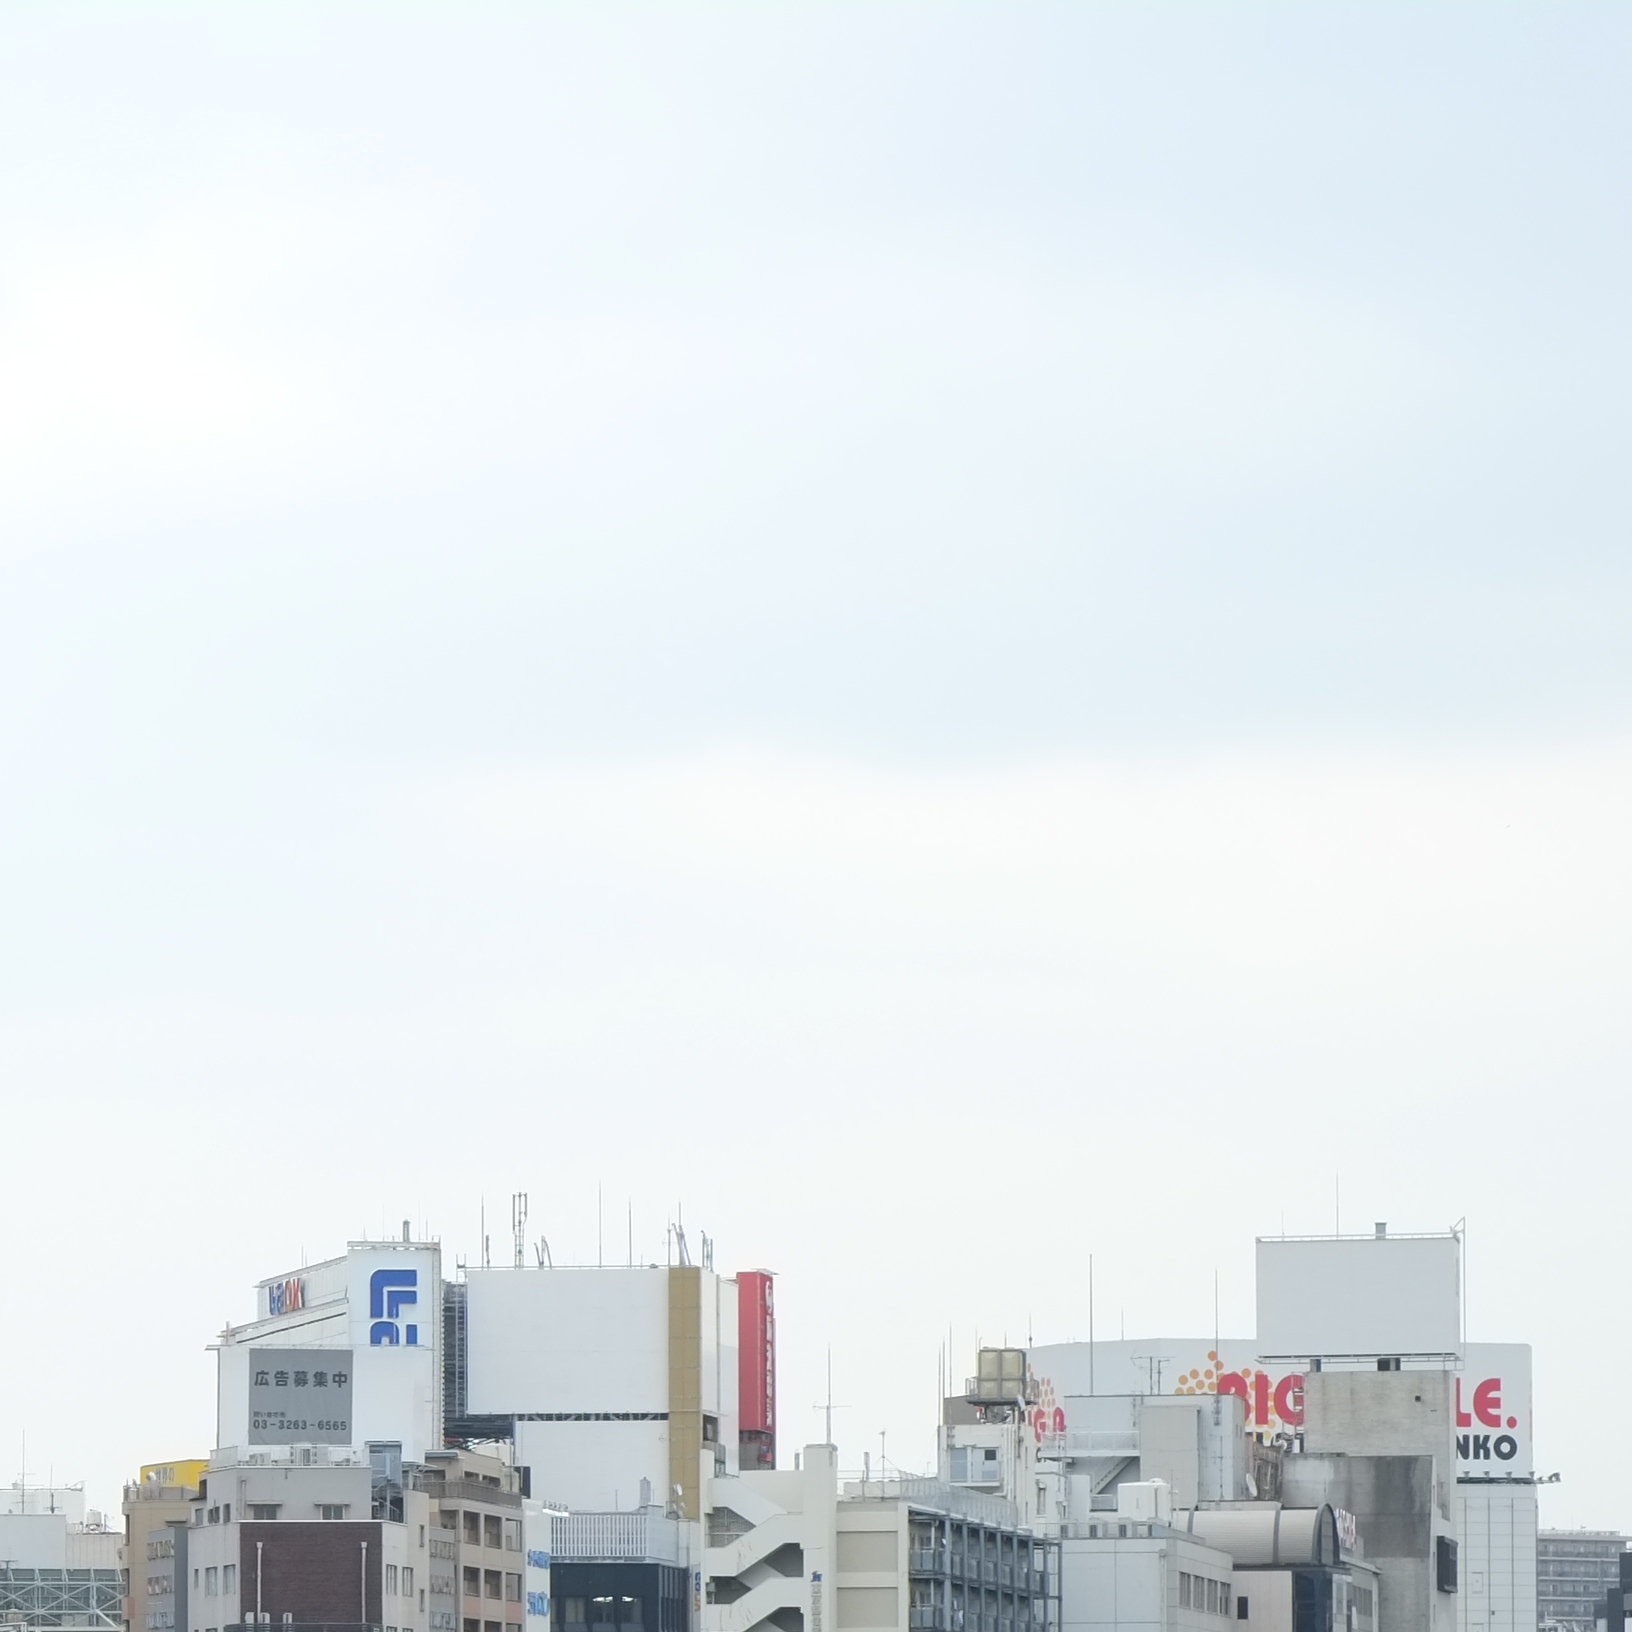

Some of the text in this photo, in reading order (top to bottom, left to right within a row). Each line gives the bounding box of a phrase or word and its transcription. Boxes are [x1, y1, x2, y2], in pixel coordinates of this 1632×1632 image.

[254, 1370, 348, 1388] 広告募集中
